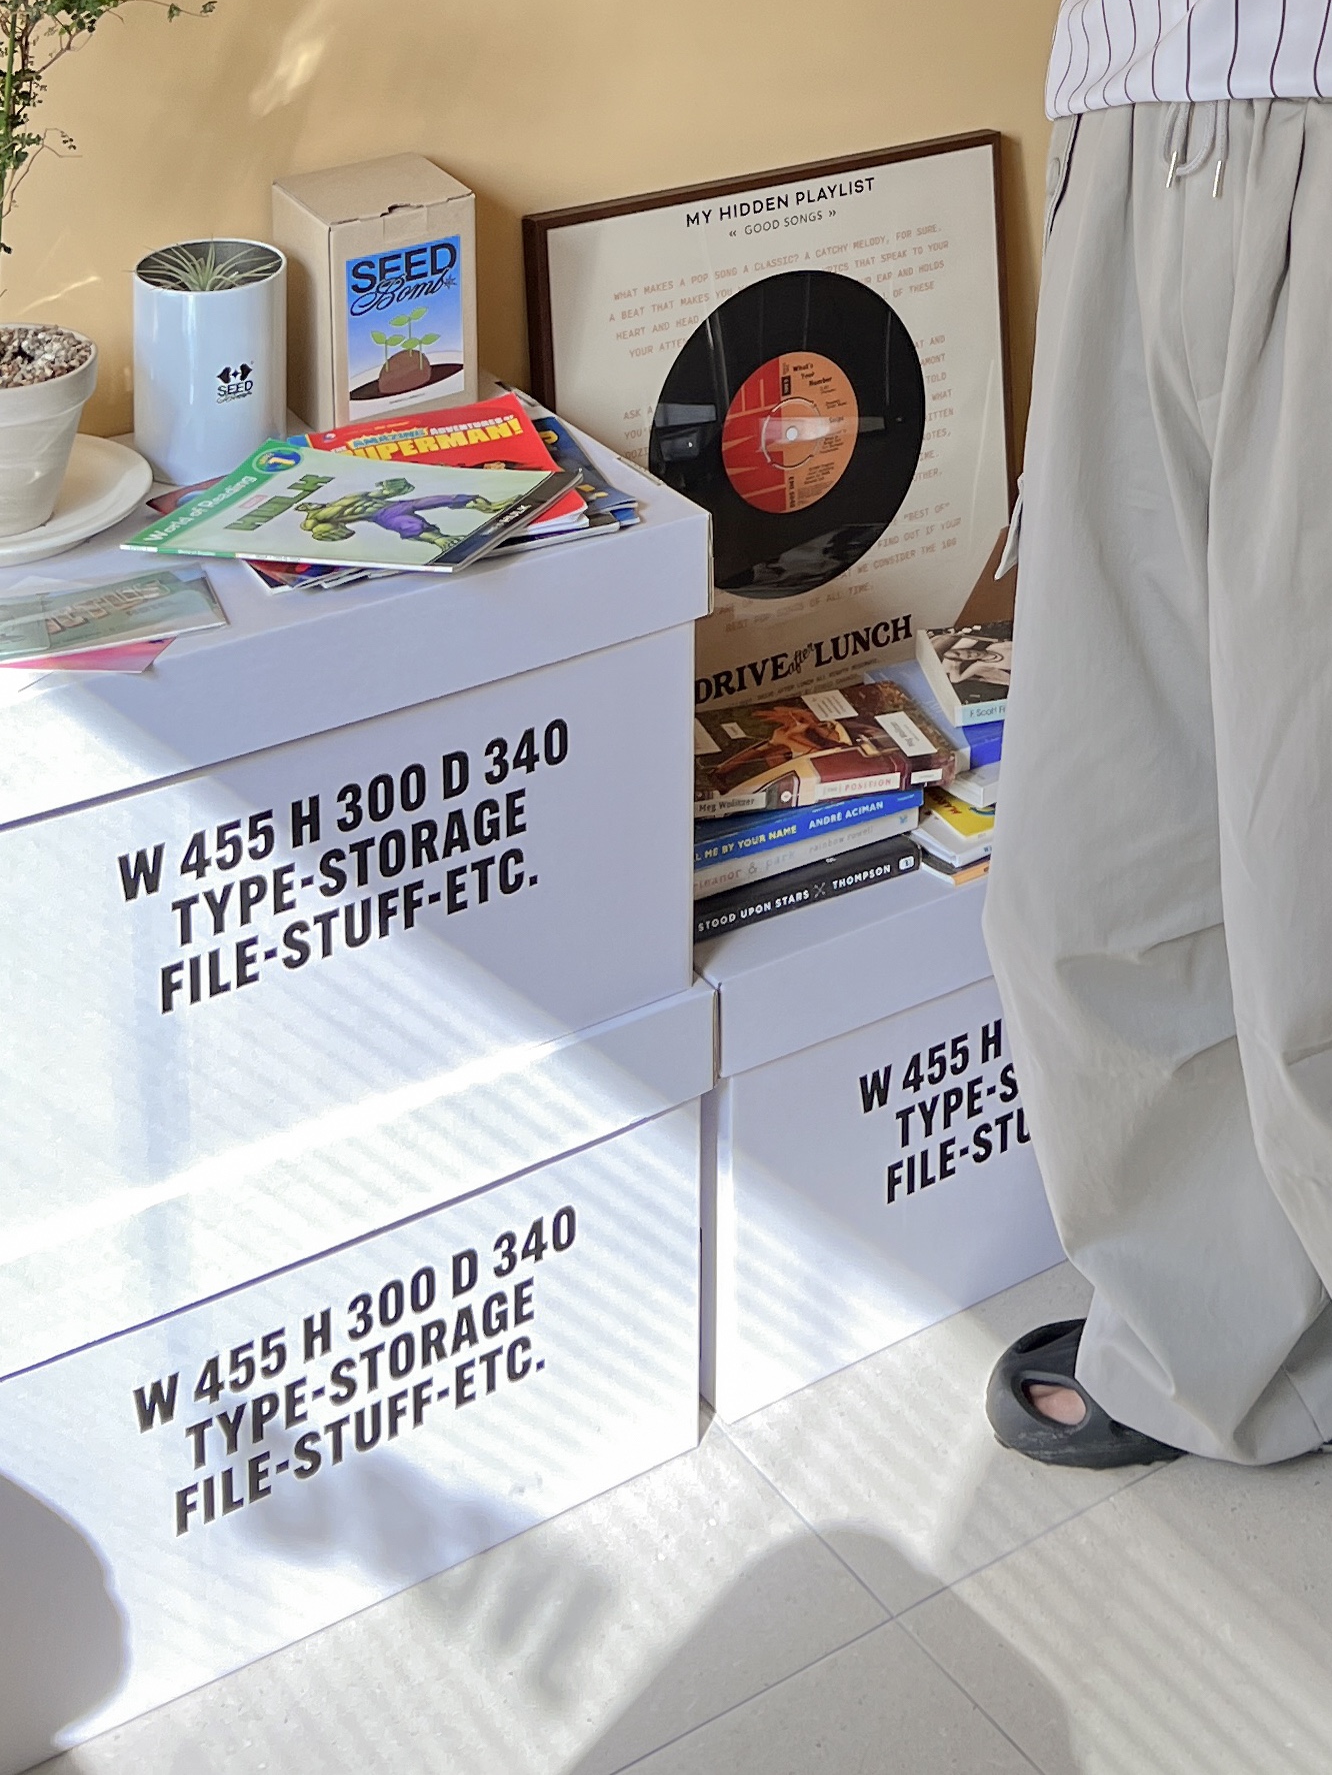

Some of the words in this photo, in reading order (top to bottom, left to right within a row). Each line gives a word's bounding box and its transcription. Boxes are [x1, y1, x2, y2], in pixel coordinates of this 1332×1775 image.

[686, 210, 712, 228] MY
[719, 194, 790, 221] HIDDEN
[796, 177, 876, 206] PLAYLIST
[745, 219, 780, 236] GOOD
[784, 211, 823, 228] SONGS
[350, 268, 449, 317] Bomb
[352, 243, 457, 295] SEED
[613, 288, 638, 301] WHAT
[644, 281, 674, 295] MAKES
[680, 278, 686, 287] A
[691, 273, 709, 285] POP
[715, 267, 738, 280] SONG
[743, 265, 749, 273] A
[754, 254, 800, 271] CLASSIC?
[804, 251, 811, 260] A
[816, 243, 848, 258] CATCHY
[853, 235, 889, 250] MELODY,
[896, 229, 912, 241] FOR
[916, 224, 941, 237] SURE.
[217, 380, 254, 398] SEED
[347, 418, 524, 461] UPERMAN!
[352, 428, 426, 449] AMAZING
[144, 517, 192, 542] World
[199, 475, 258, 510] Reading
[695, 653, 788, 705] DRIVE
[815, 614, 912, 668] LUNCH
[118, 841, 165, 902] W
[180, 808, 275, 881] 455
[291, 795, 321, 849] H
[337, 763, 426, 833] 300
[442, 749, 469, 799] D
[485, 718, 570, 786] 340
[844, 778, 892, 792] POSITION
[705, 847, 719, 858] ME
[722, 842, 735, 855] BY
[737, 834, 766, 850] YOUR
[768, 825, 797, 841] NAME
[845, 801, 884, 819] ACIMAN
[171, 787, 528, 947] TYPE-STORAGE
[698, 913, 736, 932] STOOD
[740, 902, 772, 919] UPON
[775, 889, 810, 908] STARS
[832, 865, 892, 889] THOMPSON
[161, 847, 539, 1015] FILE-STUFF-ETC.
[859, 1064, 892, 1114] W
[902, 1032, 969, 1094] 455
[981, 1018, 1003, 1064] H
[895, 1062, 1019, 1148] TYPE-S
[887, 1107, 1031, 1205] FILE-STU
[133, 1371, 180, 1434] W
[194, 1328, 286, 1405] 455
[303, 1307, 332, 1362] H
[347, 1265, 436, 1343] 300
[451, 1247, 478, 1299] D
[493, 1205, 577, 1280] 340
[184, 1276, 535, 1471] TYPE-STORAGE
[175, 1336, 546, 1538] FILE-STUFF-ETC.
